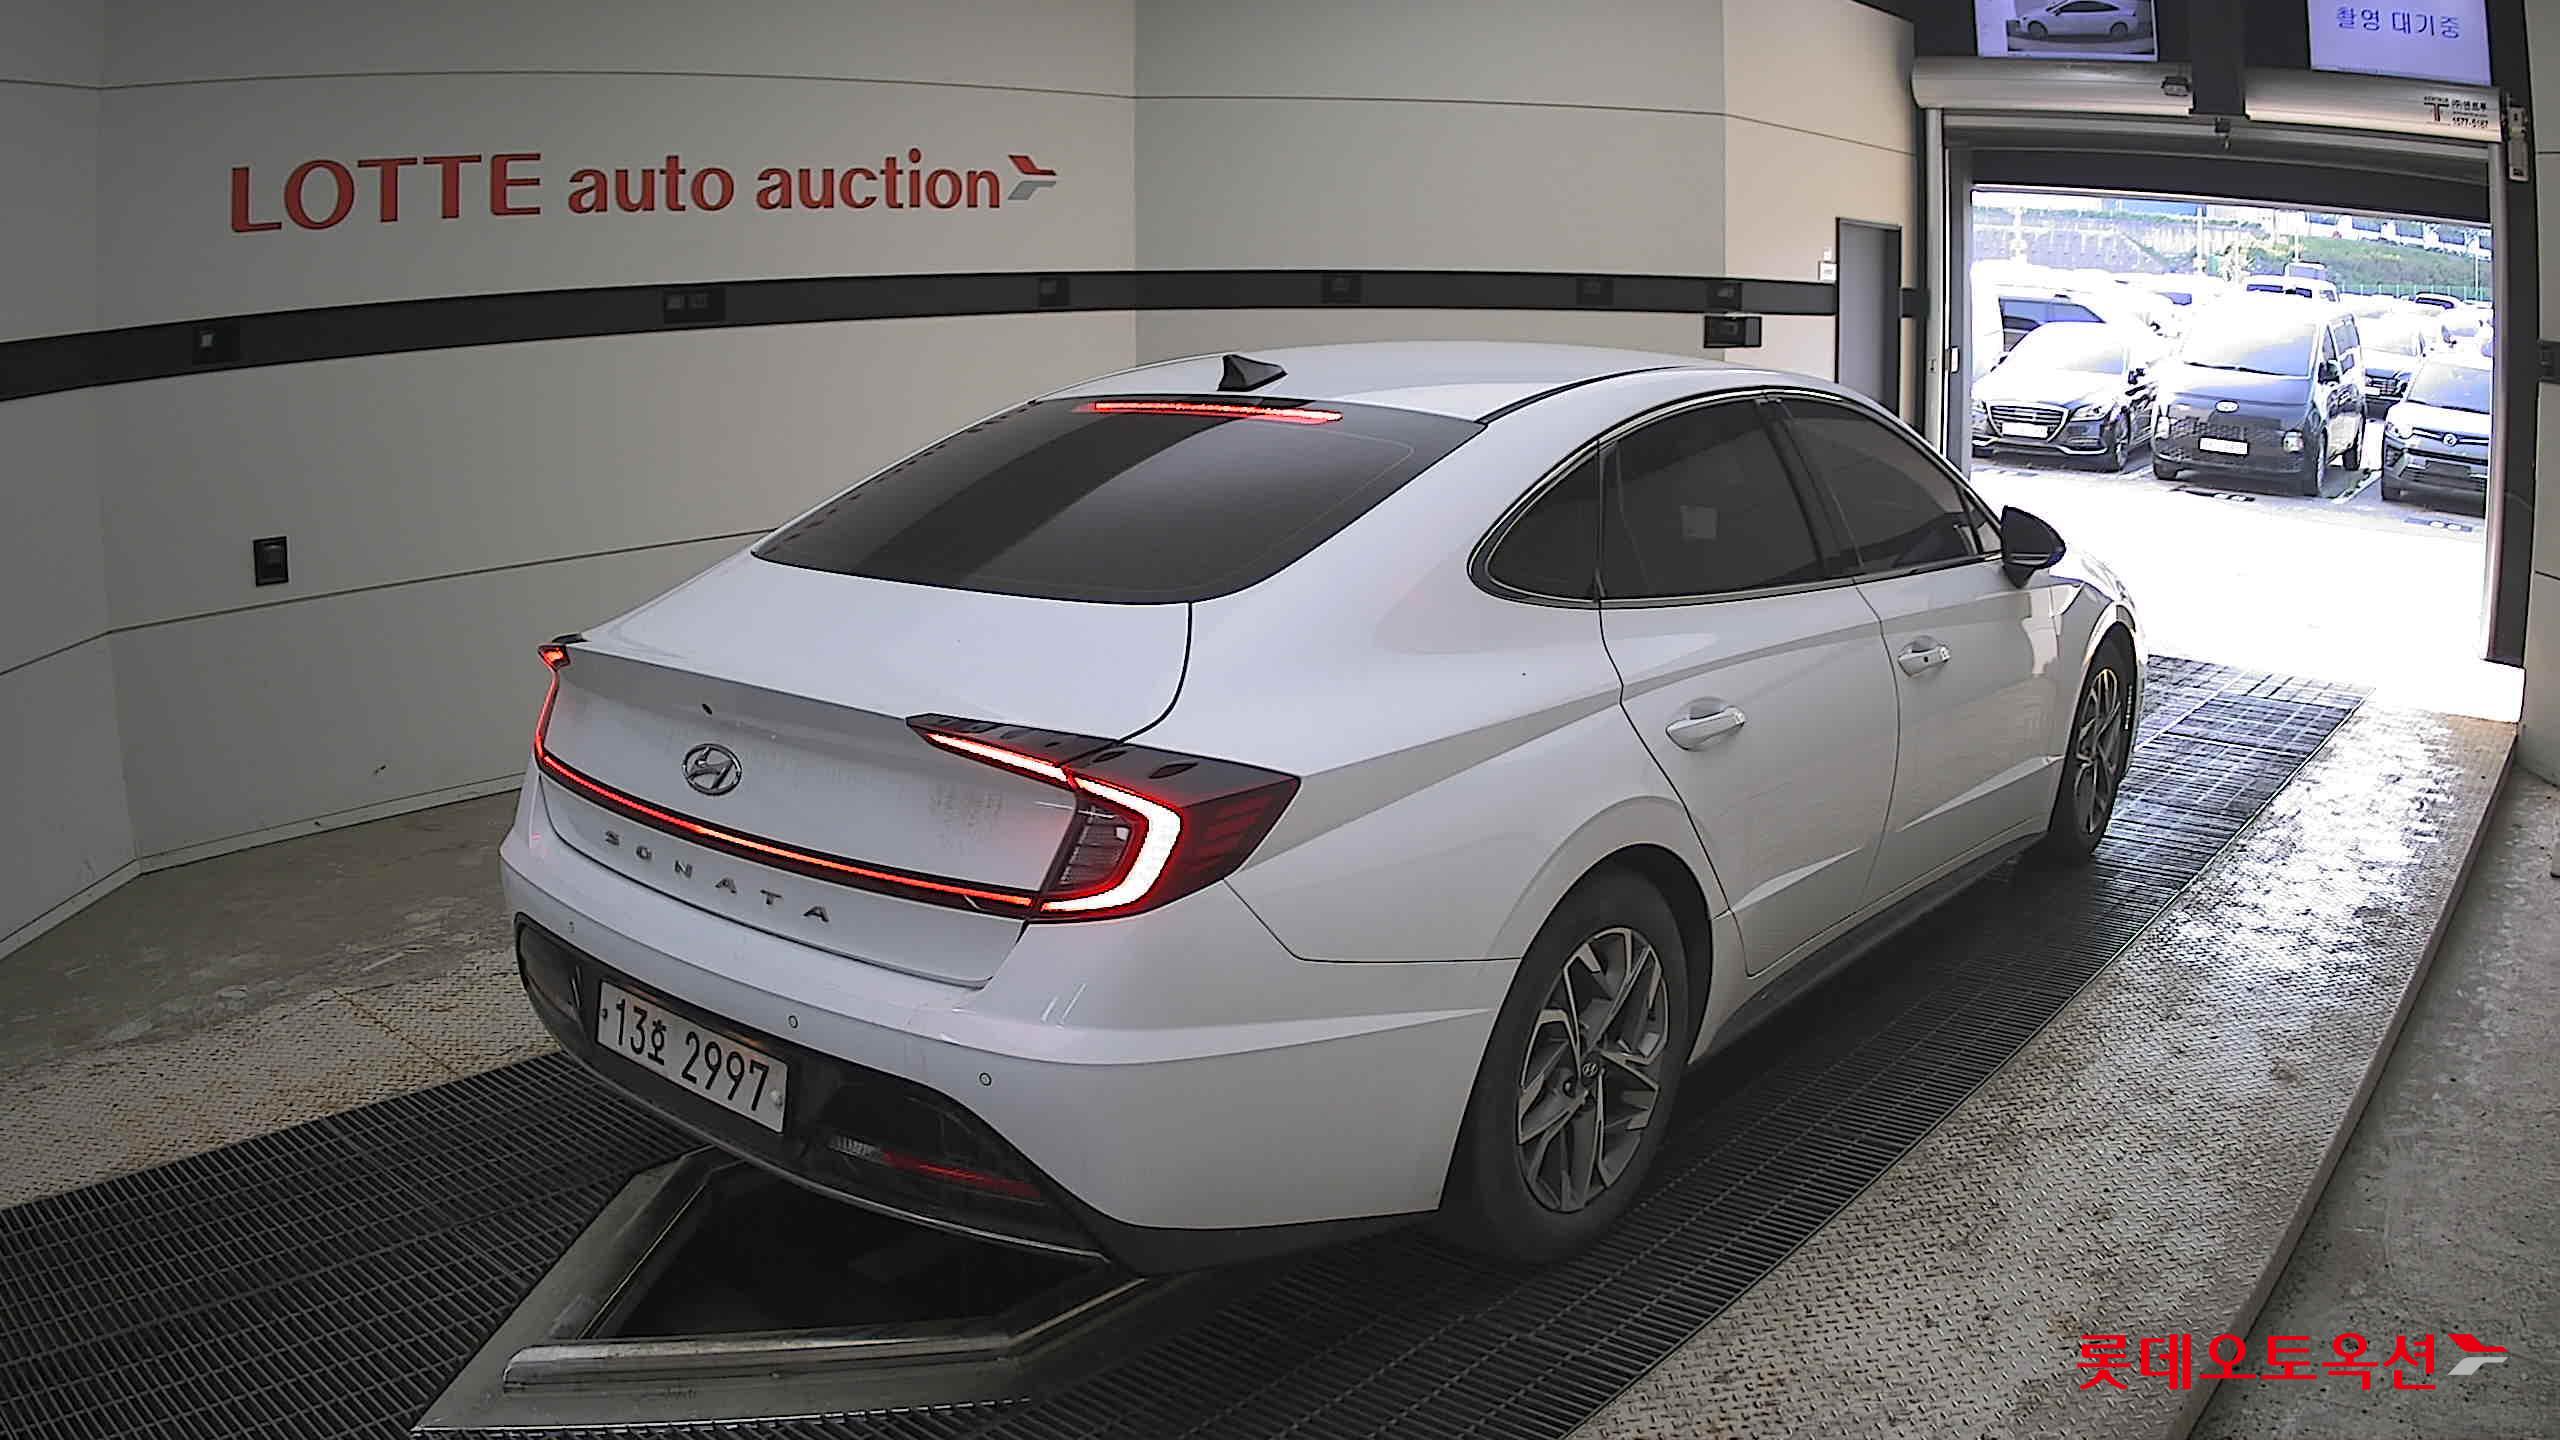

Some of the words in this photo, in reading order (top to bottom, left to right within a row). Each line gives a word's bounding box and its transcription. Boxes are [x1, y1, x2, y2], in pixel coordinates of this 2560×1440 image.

[2337, 7, 2380, 31] 촬영
[2391, 11, 2460, 39] 대기중
[231, 153, 542, 234] LOTTE
[567, 155, 735, 214] auto
[755, 148, 1002, 210] auction
[605, 830, 830, 923] SONATA
[615, 998, 667, 1066] 13호
[680, 1031, 770, 1111] 2997
